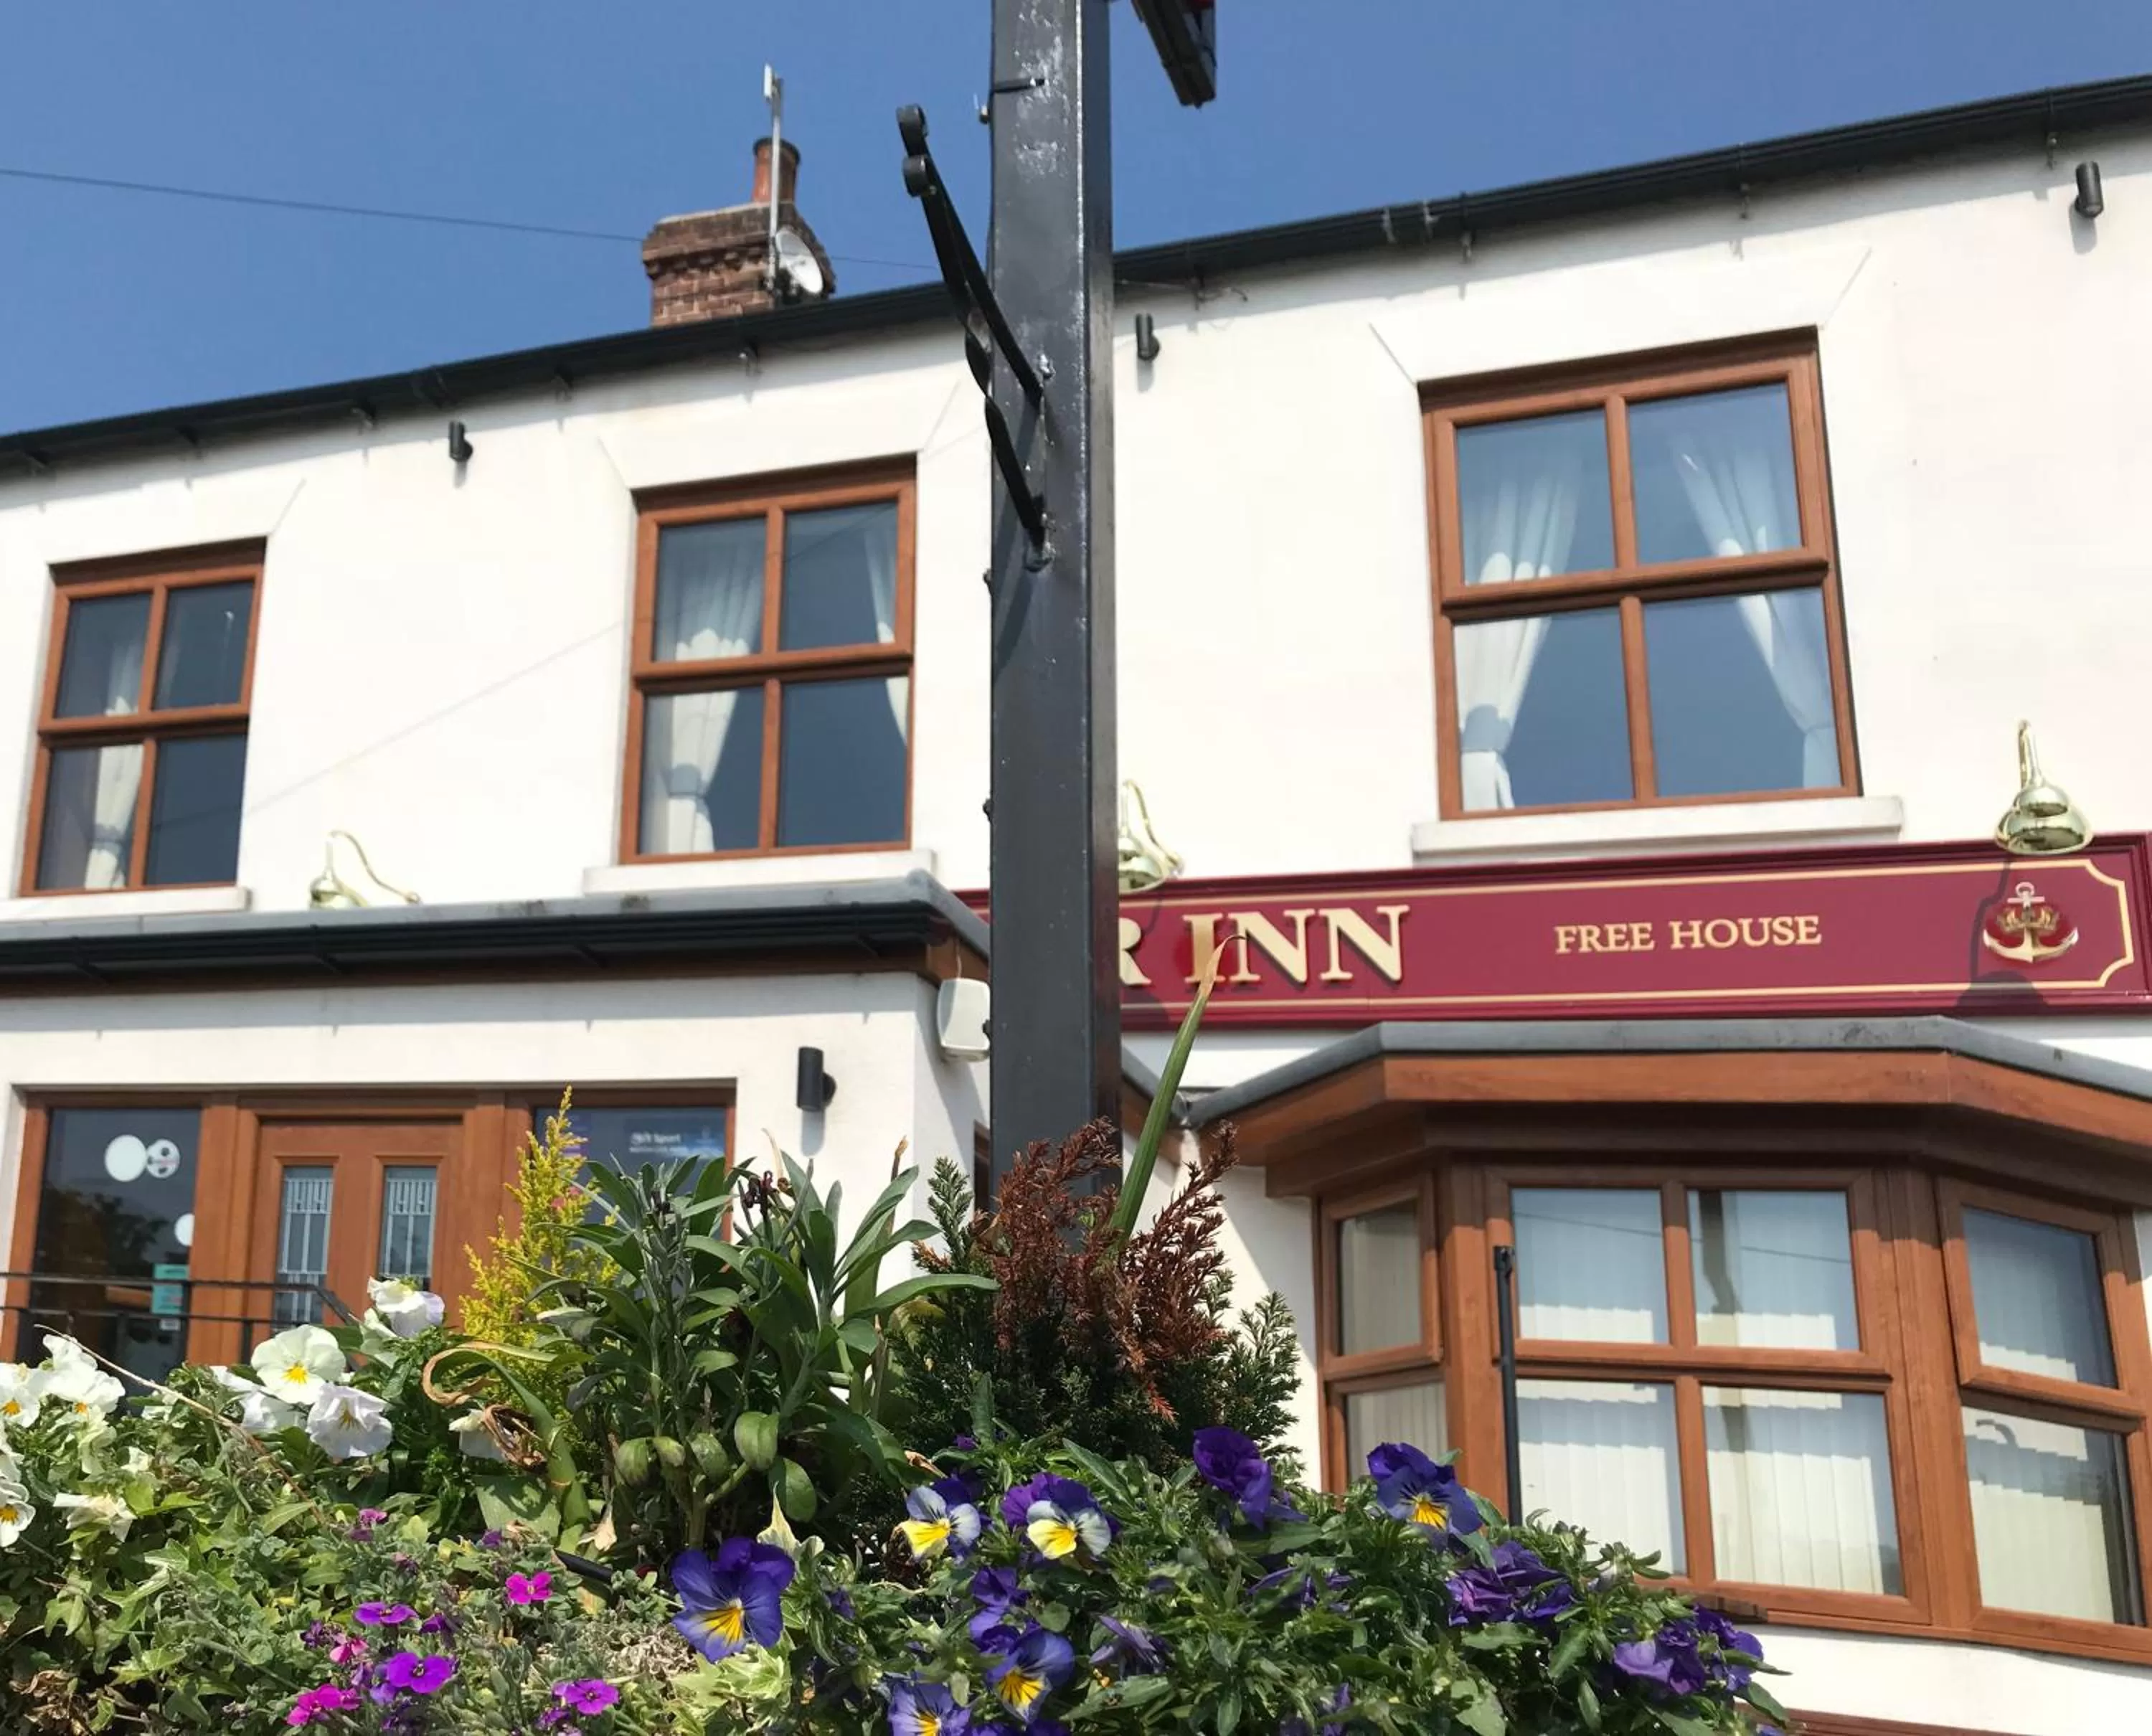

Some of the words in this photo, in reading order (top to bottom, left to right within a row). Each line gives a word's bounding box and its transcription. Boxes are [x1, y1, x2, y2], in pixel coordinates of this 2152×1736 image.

[1182, 905, 1410, 984] INN
[1554, 923, 1655, 954] FREE
[1669, 915, 1822, 950] HOUSE
